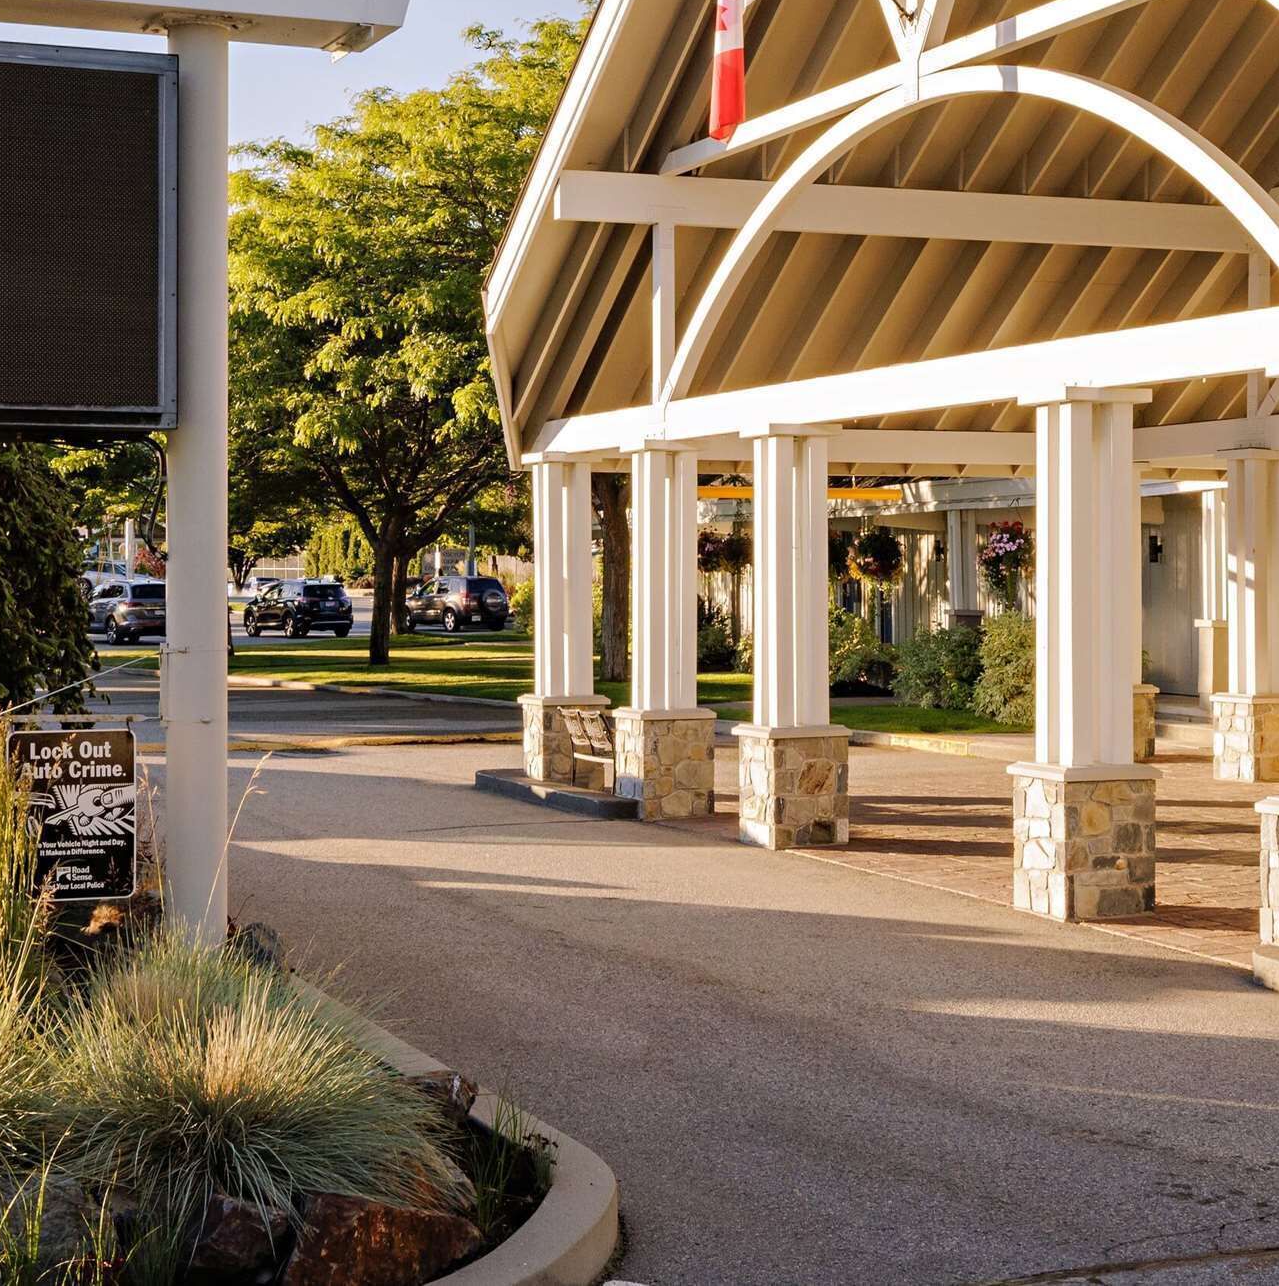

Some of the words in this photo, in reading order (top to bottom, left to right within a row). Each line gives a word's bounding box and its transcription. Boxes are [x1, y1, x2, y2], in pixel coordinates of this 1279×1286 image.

[30, 741, 74, 760] Lock
[79, 740, 112, 759] Out
[20, 761, 63, 780] Auto
[68, 760, 127, 778] Crime.
[42, 841, 56, 849] Your
[57, 840, 81, 848] Vehicle
[81, 839, 99, 848] Night
[71, 865, 90, 874] Road
[71, 873, 93, 882] Sense
[70, 882, 86, 890] Local
[86, 881, 105, 889] Police
